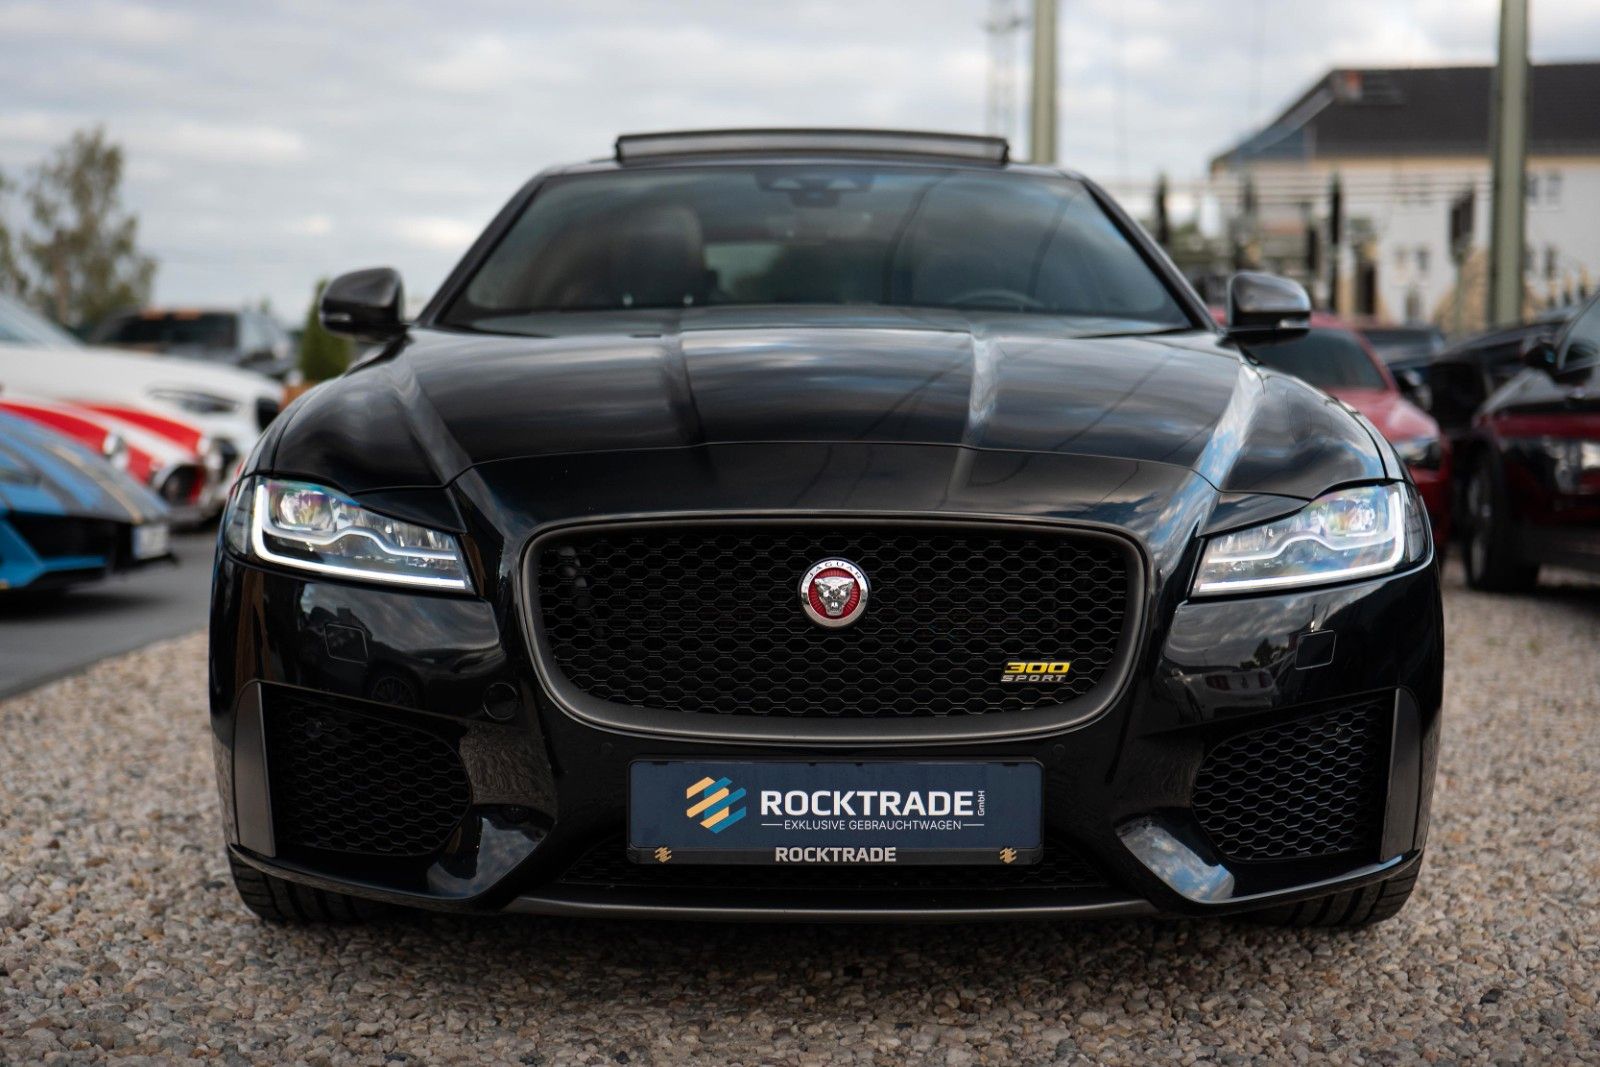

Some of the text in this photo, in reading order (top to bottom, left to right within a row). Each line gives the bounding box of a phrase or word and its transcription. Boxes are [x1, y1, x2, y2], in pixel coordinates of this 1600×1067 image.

[809, 561, 862, 579] JAGUAR
[1005, 662, 1070, 674] 300
[1001, 674, 1066, 682] SPORT
[760, 790, 985, 816] ROCKTRADE GmbH
[784, 820, 962, 830] EXKLUSIVE GEBRAUCHTWAGEN
[775, 846, 897, 863] ROCKTRADE
